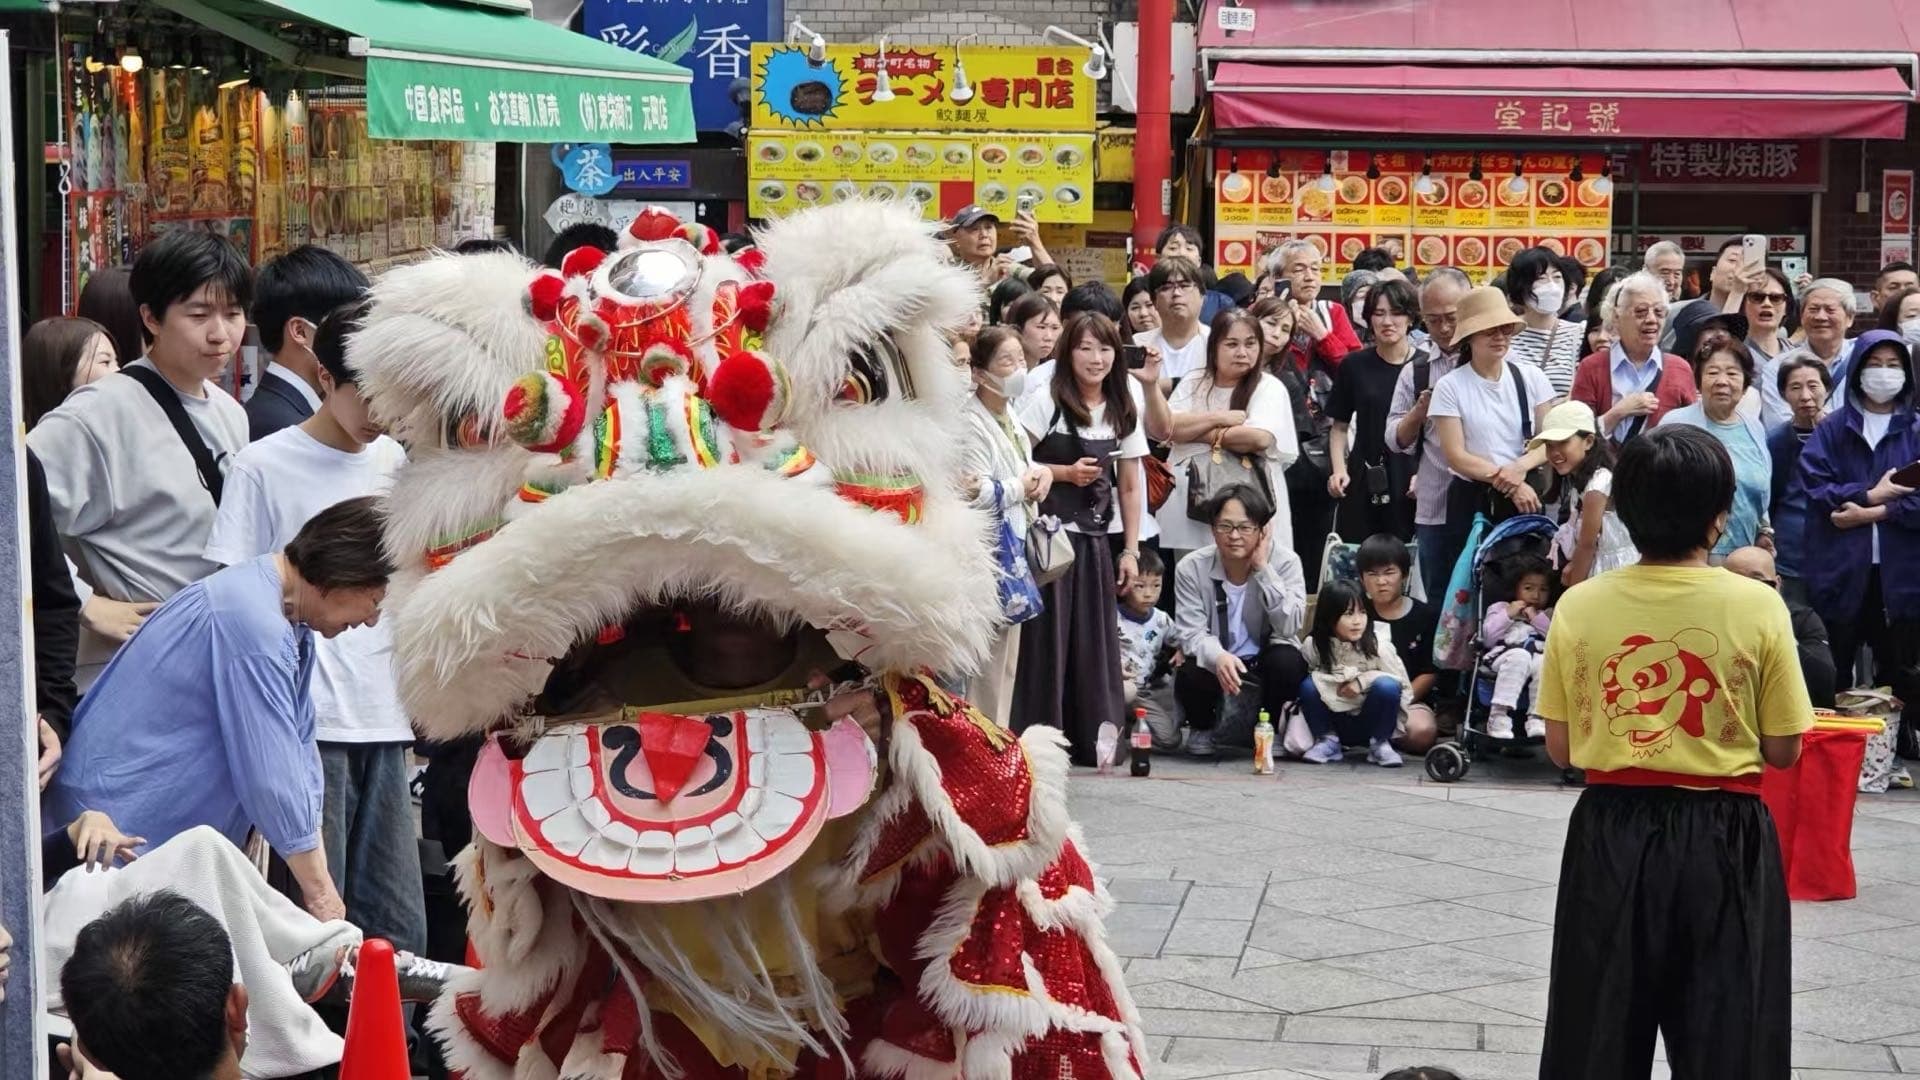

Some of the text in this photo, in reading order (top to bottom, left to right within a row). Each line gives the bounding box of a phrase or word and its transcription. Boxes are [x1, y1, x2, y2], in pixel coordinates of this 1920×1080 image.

[1036, 57, 1074, 76] 屋台
[404, 84, 465, 124] 中国食料品
[574, 149, 611, 191] 茶
[1650, 142, 1799, 178] 特製焼豚
[623, 166, 682, 183] 出入平安
[1638, 234, 1796, 253] 特製豚
